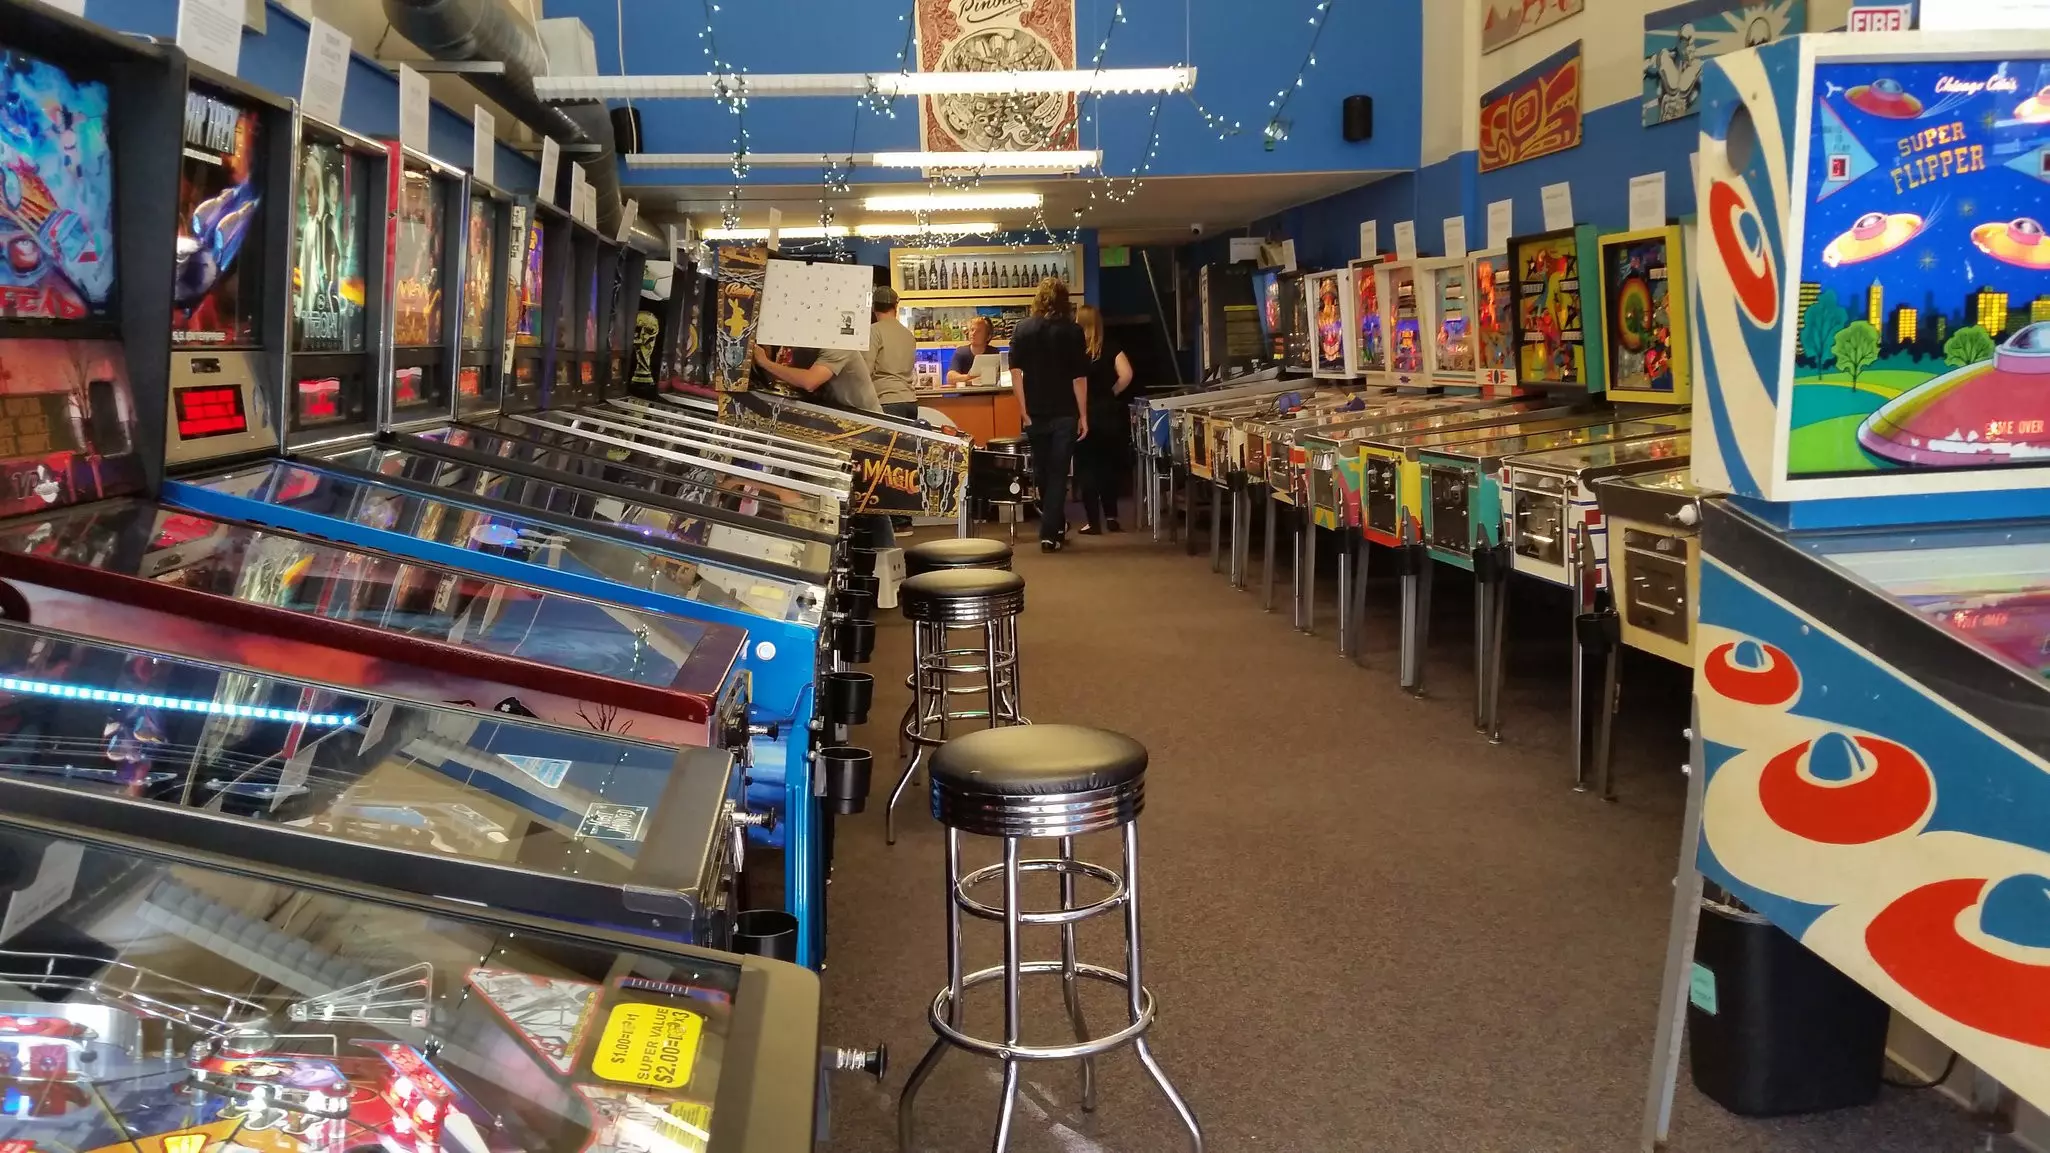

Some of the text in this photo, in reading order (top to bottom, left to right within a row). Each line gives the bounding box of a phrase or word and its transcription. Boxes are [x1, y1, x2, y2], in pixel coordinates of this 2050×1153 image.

[958, 0, 1025, 17] Pinba
[1853, 12, 1900, 31] FIRE
[1897, 121, 1966, 157] SUPER
[1890, 144, 1986, 195] FLIPPER
[2018, 420, 2044, 433] OVER
[863, 458, 920, 494] MAGIC
[637, 1008, 669, 1080] SUPER VALUE
